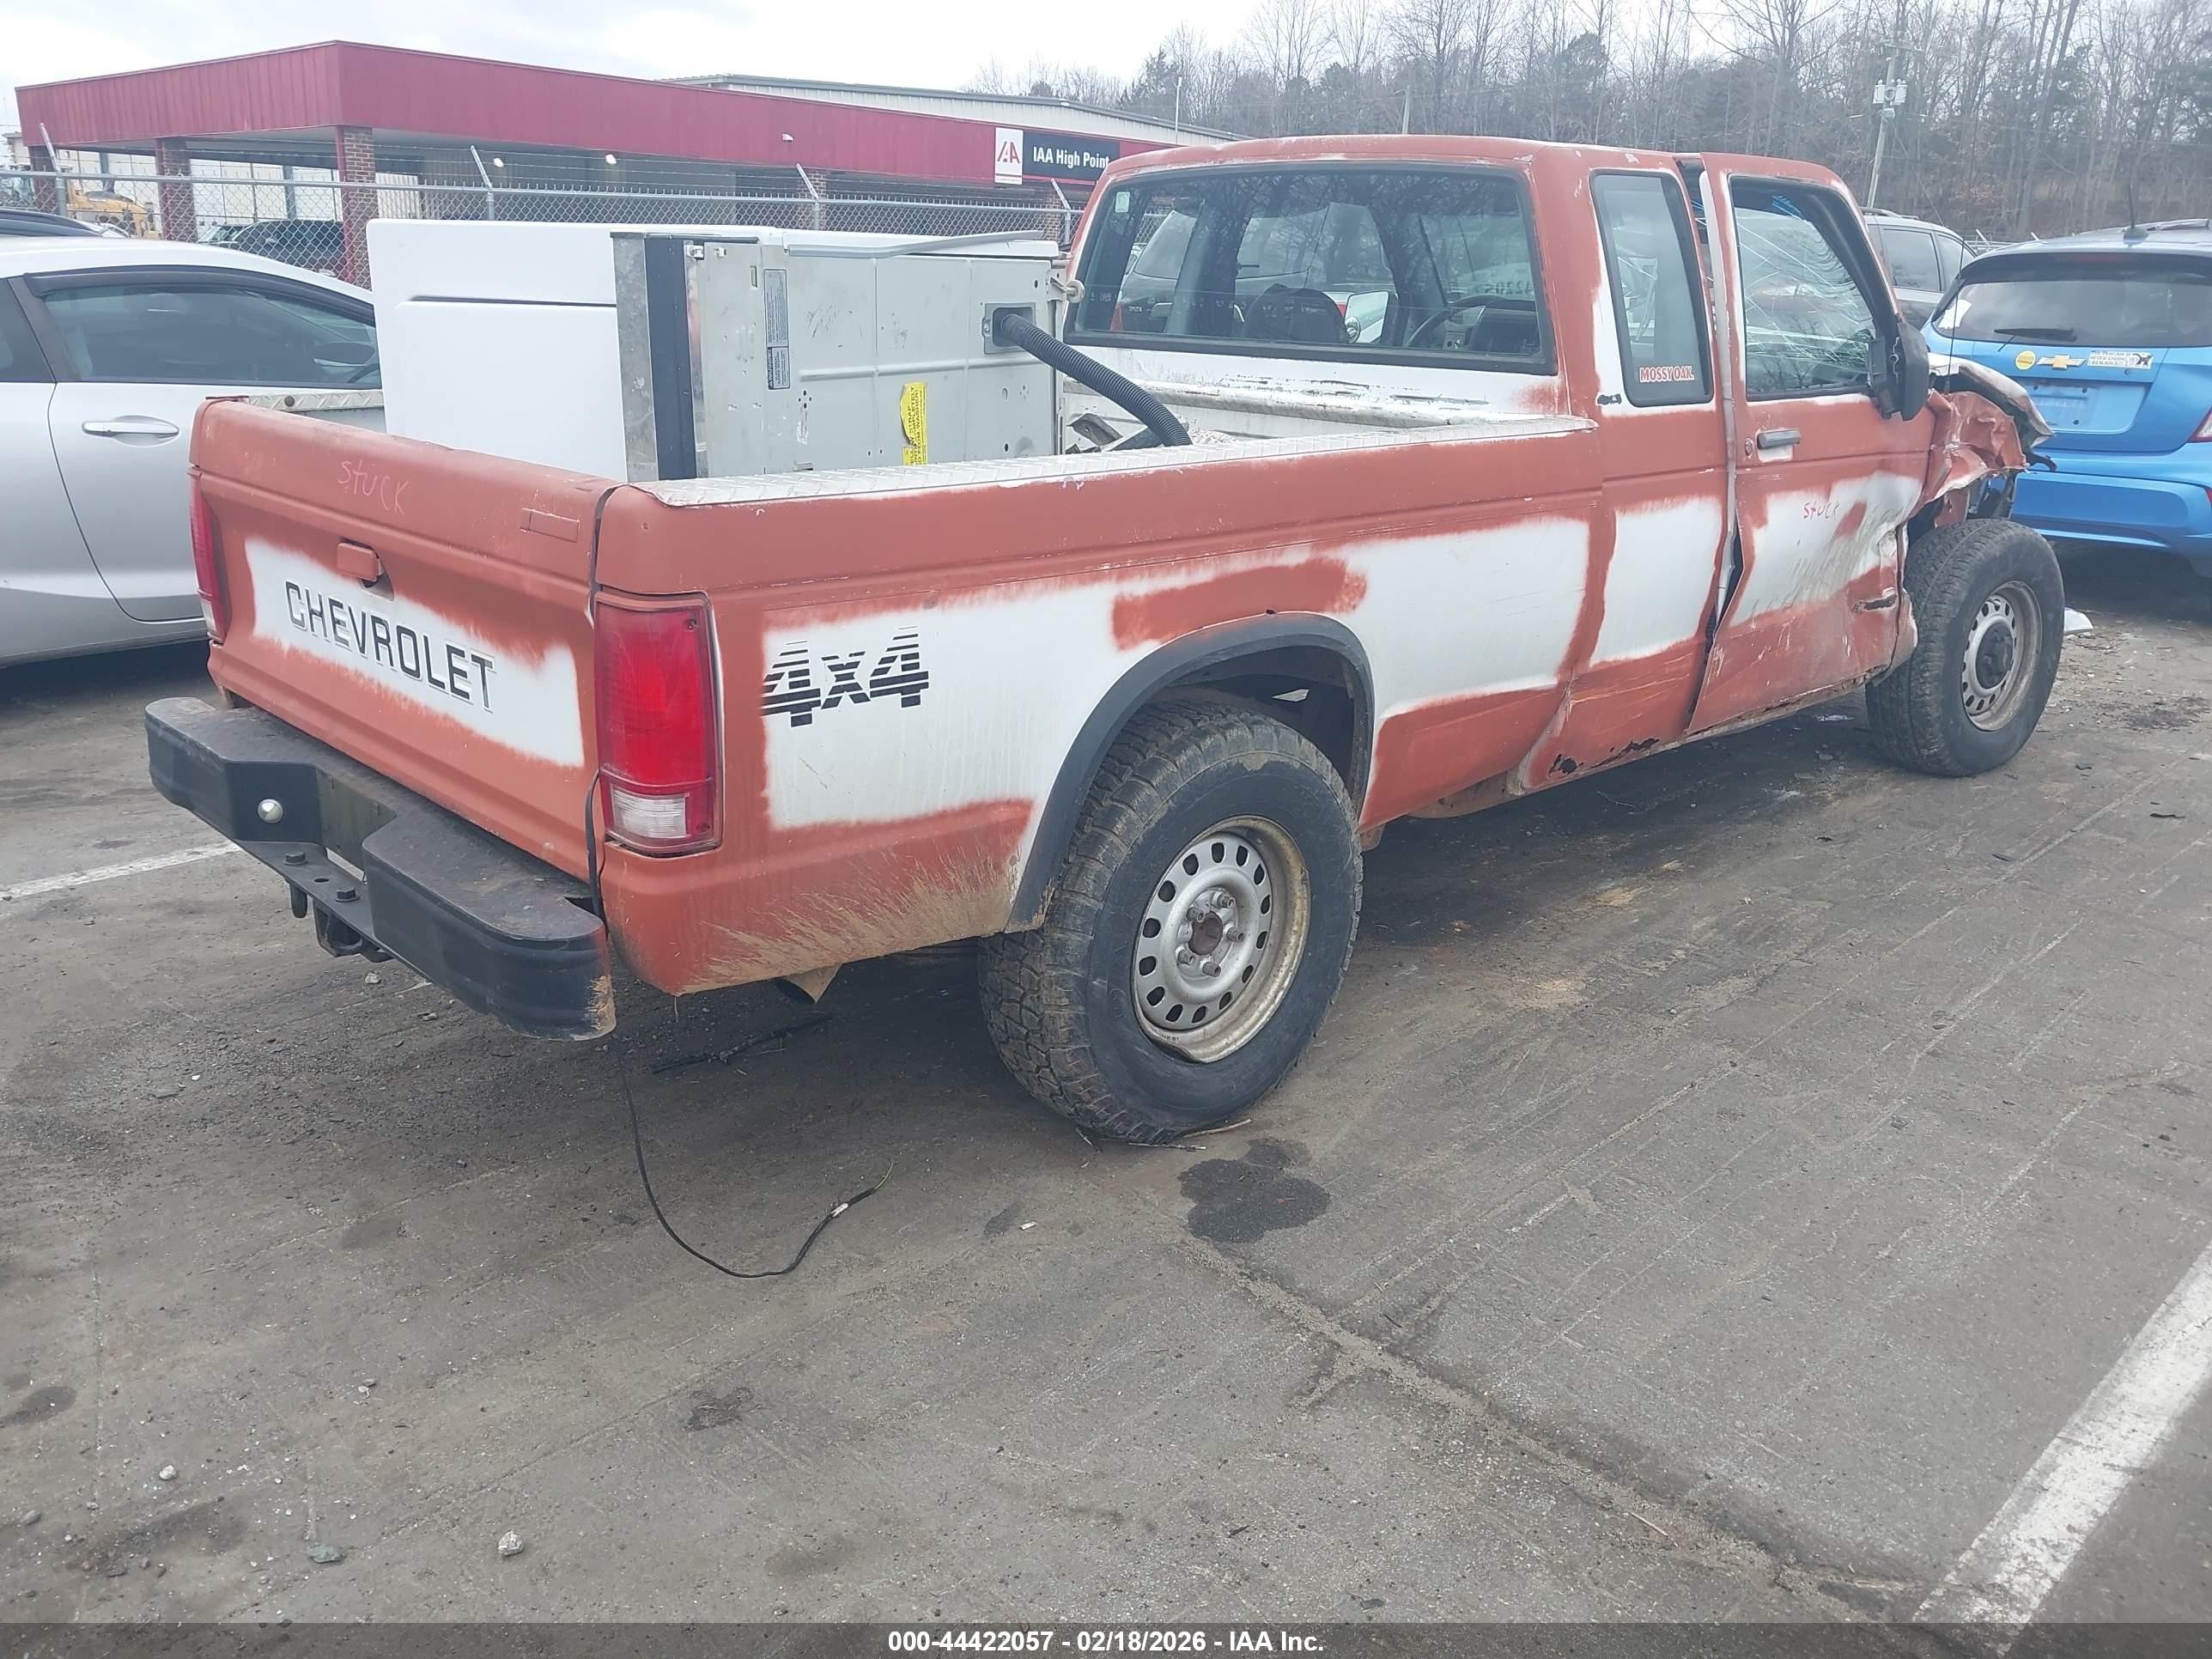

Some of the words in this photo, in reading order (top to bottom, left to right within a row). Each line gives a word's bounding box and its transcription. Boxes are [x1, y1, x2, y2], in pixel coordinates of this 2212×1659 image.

[1033, 146, 1054, 163] IAA
[1056, 149, 1080, 169] High
[1083, 151, 1110, 169] Point
[1640, 367, 1673, 382] MOSSY
[285, 580, 496, 714] CHEVROLET
